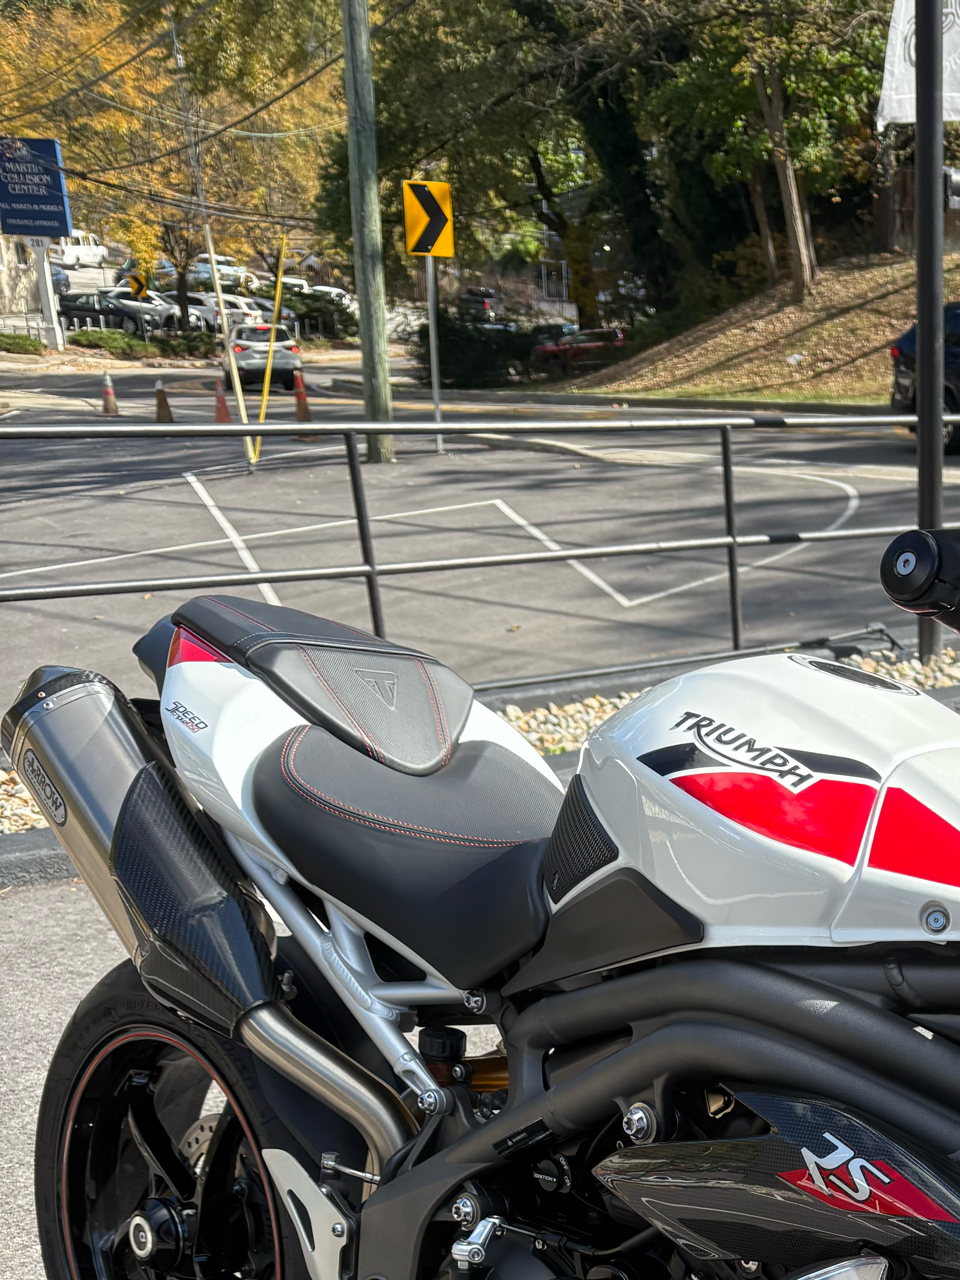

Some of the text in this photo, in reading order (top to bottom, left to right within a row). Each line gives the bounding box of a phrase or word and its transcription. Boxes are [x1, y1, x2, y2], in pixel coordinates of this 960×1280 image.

[1, 173, 51, 185] COLLISION
[8, 184, 48, 195] CENTER
[165, 701, 208, 730] SPEED
[669, 711, 814, 788] TRIUMPH
[800, 1131, 891, 1201] RS
